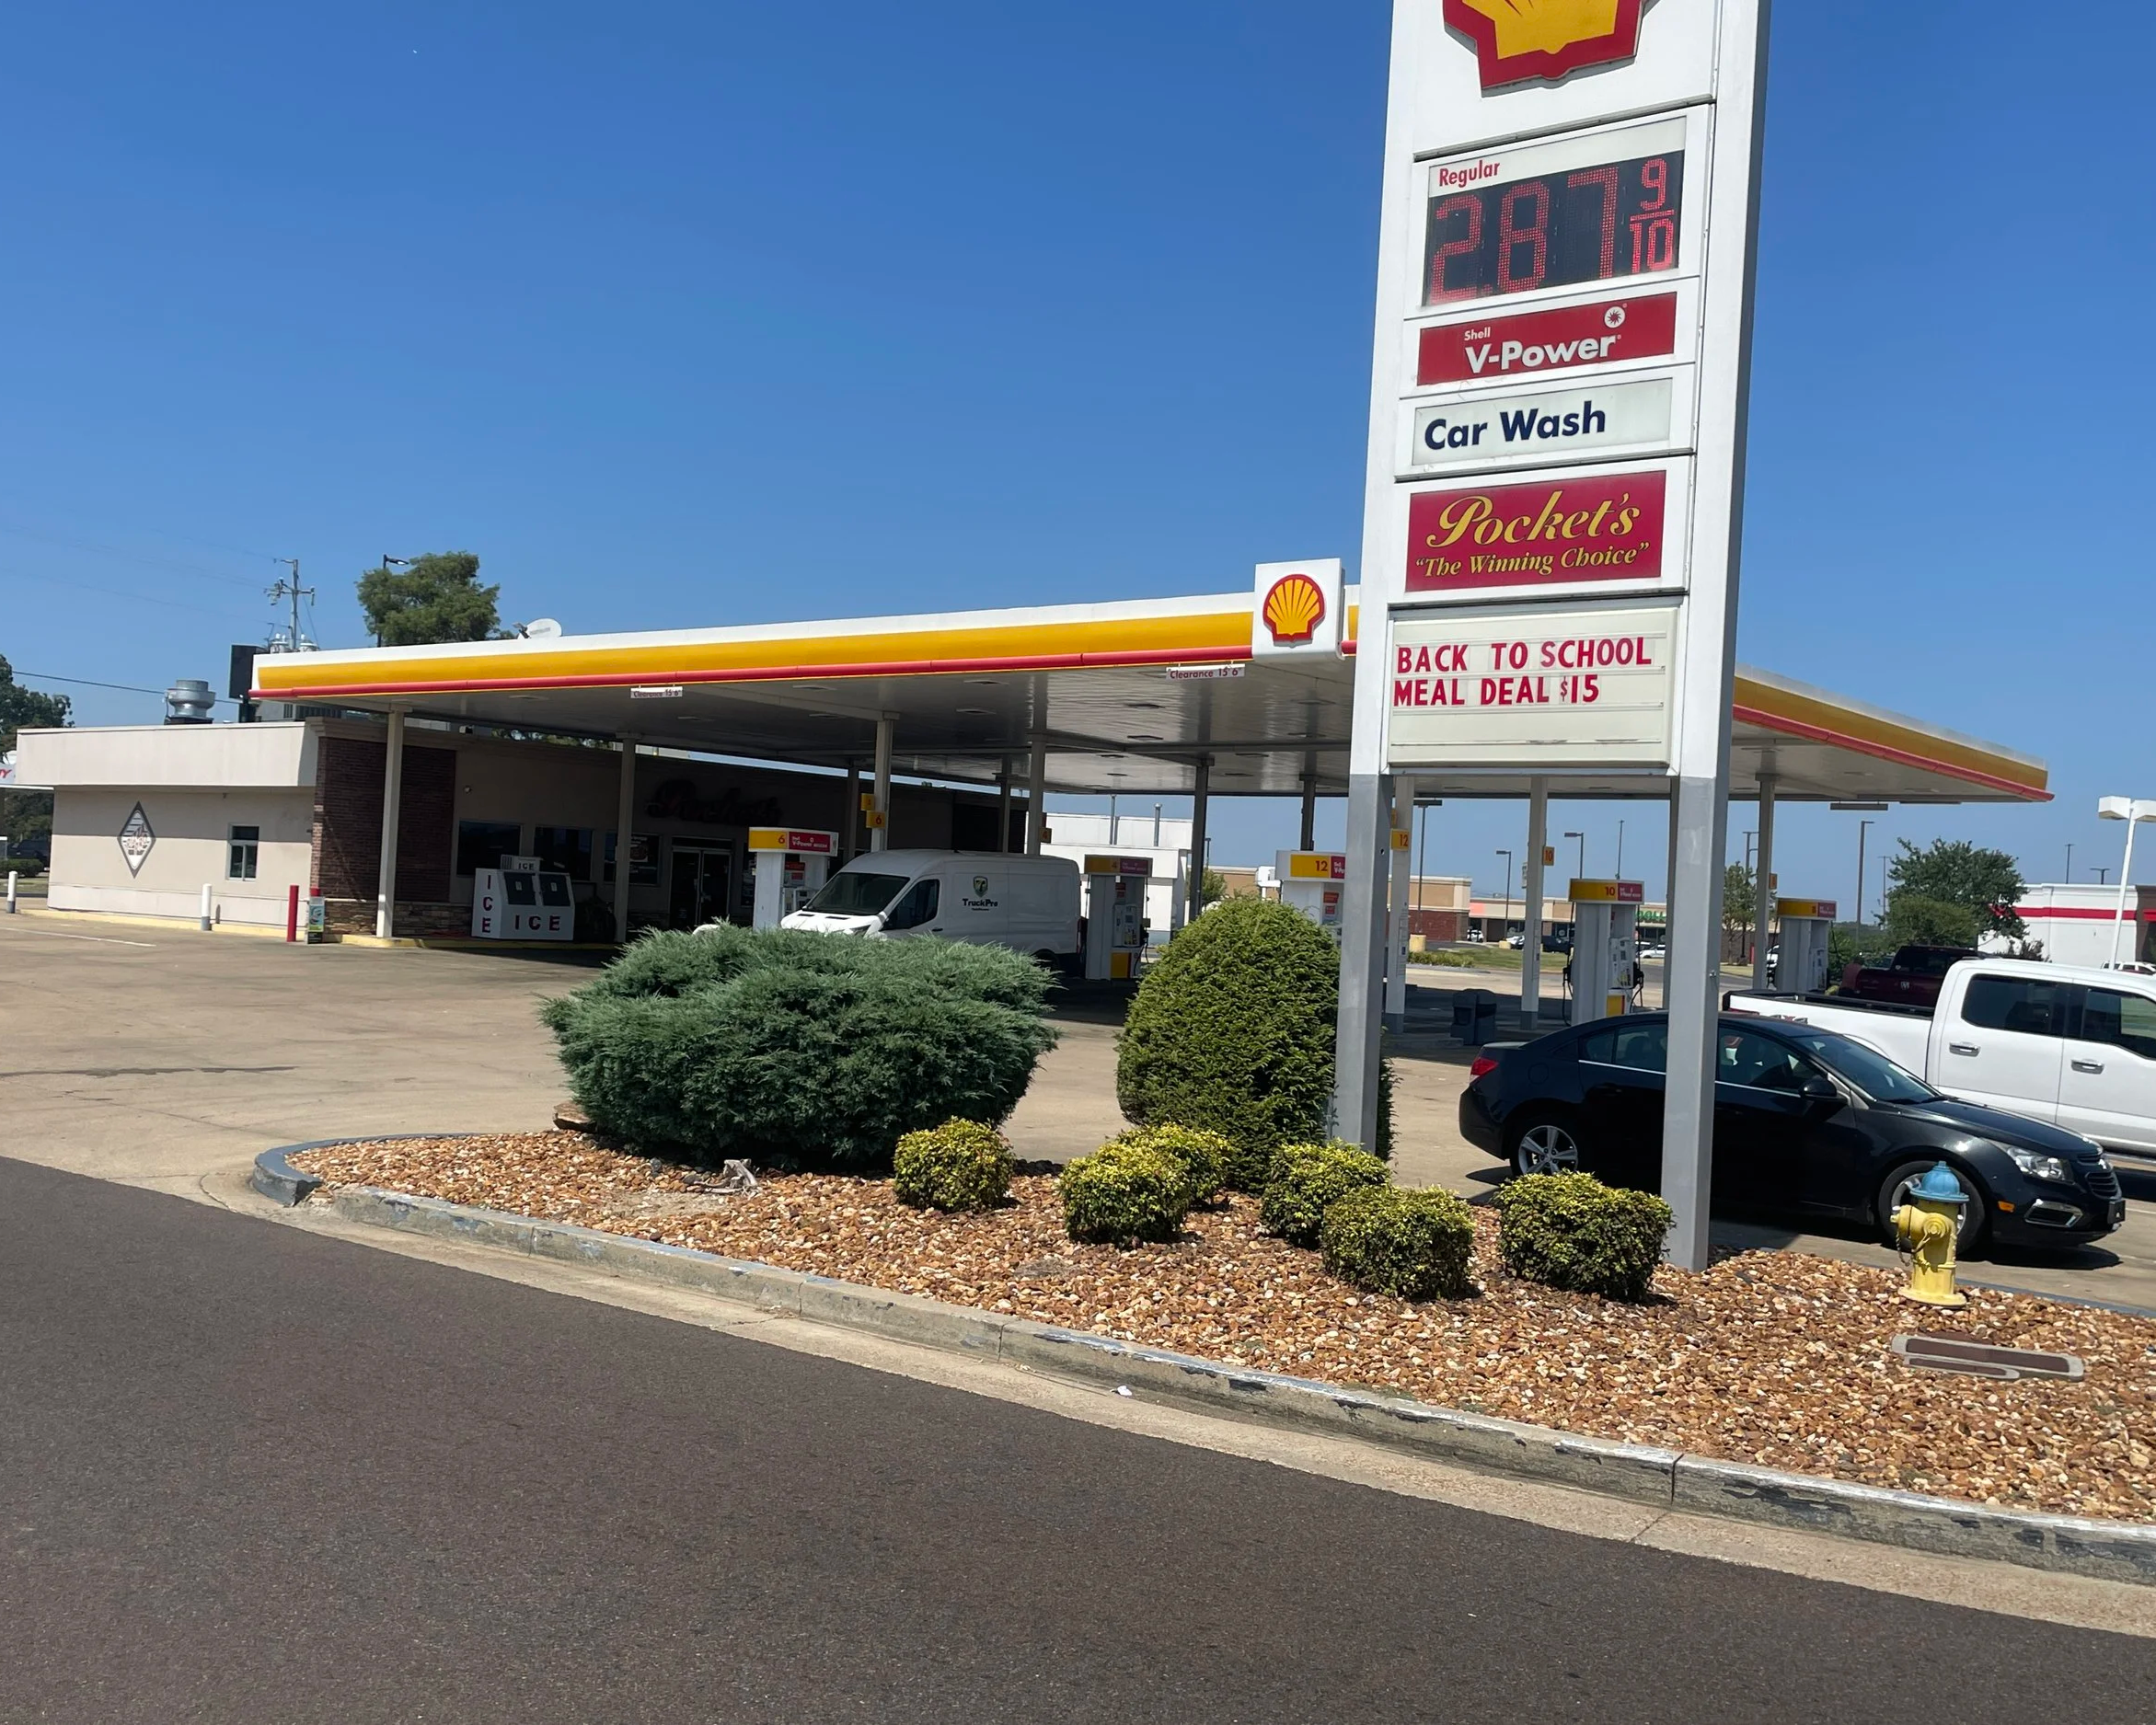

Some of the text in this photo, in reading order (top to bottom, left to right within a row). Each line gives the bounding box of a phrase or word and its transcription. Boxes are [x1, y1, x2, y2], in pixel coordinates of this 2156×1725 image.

[1439, 159, 1501, 189] Regular
[1640, 157, 1668, 211] 9
[1430, 167, 1620, 305] 2.87
[1629, 218, 1674, 274] 10
[1464, 327, 1491, 341] Shell
[1465, 334, 1617, 374] V-Power
[1424, 400, 1607, 451] Car Wash
[1425, 489, 1641, 548] Pocket's
[1470, 552, 1554, 576] Winning
[1397, 637, 1653, 674] BACK TO SCHOOL
[1170, 670, 1214, 679] Clearance
[1393, 673, 1599, 707] MEAL DEAL $15
[778, 834, 786, 844] 6
[1400, 834, 1409, 846] 12
[518, 862, 535, 870] ICE
[1315, 860, 1328, 872] 12
[1544, 850, 1553, 862] 10
[1604, 886, 1616, 897] 10
[515, 914, 561, 932] ICE
[1635, 910, 1666, 919] DOLL
